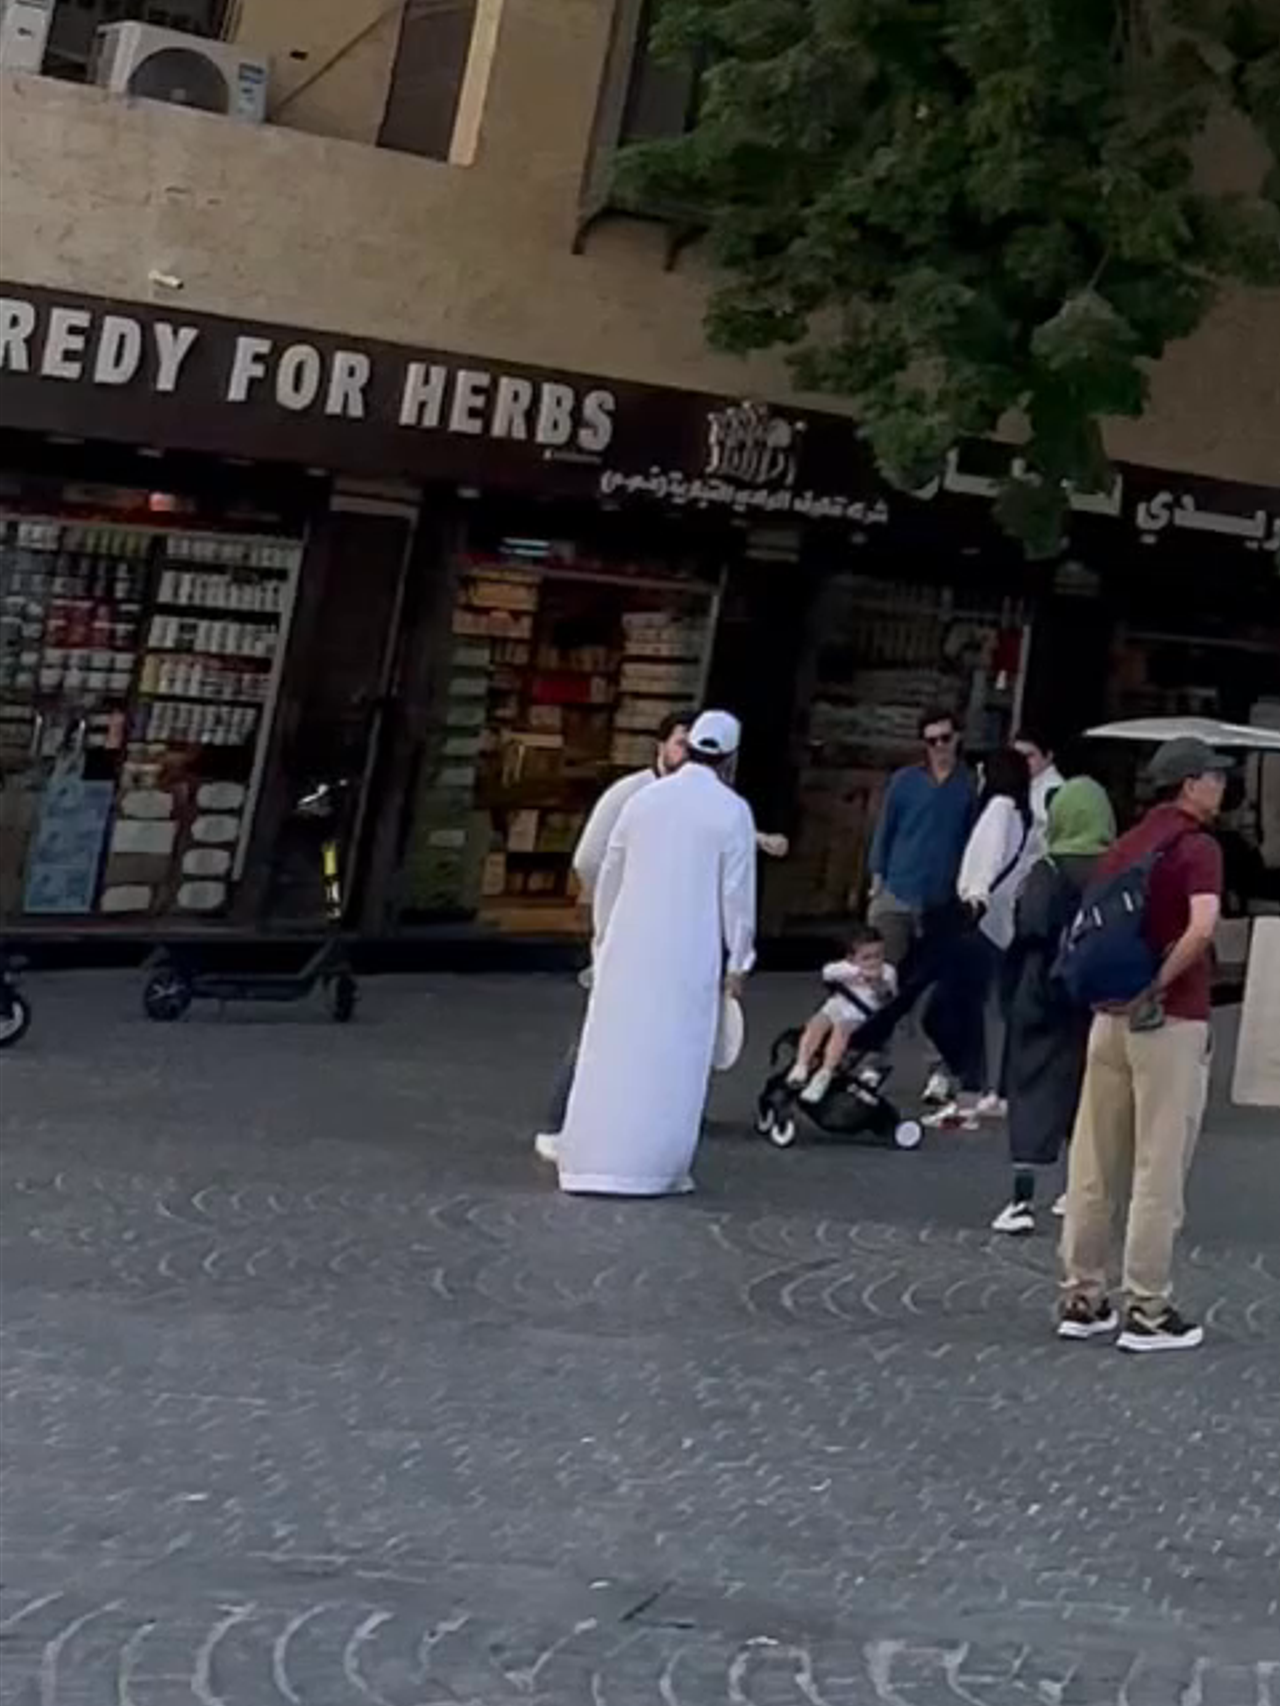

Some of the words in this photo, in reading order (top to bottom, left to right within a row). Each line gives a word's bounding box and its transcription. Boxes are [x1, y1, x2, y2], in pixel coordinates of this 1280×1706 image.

[0, 297, 198, 391] REDY
[226, 336, 371, 418] FOR
[399, 362, 616, 451] HERBS
